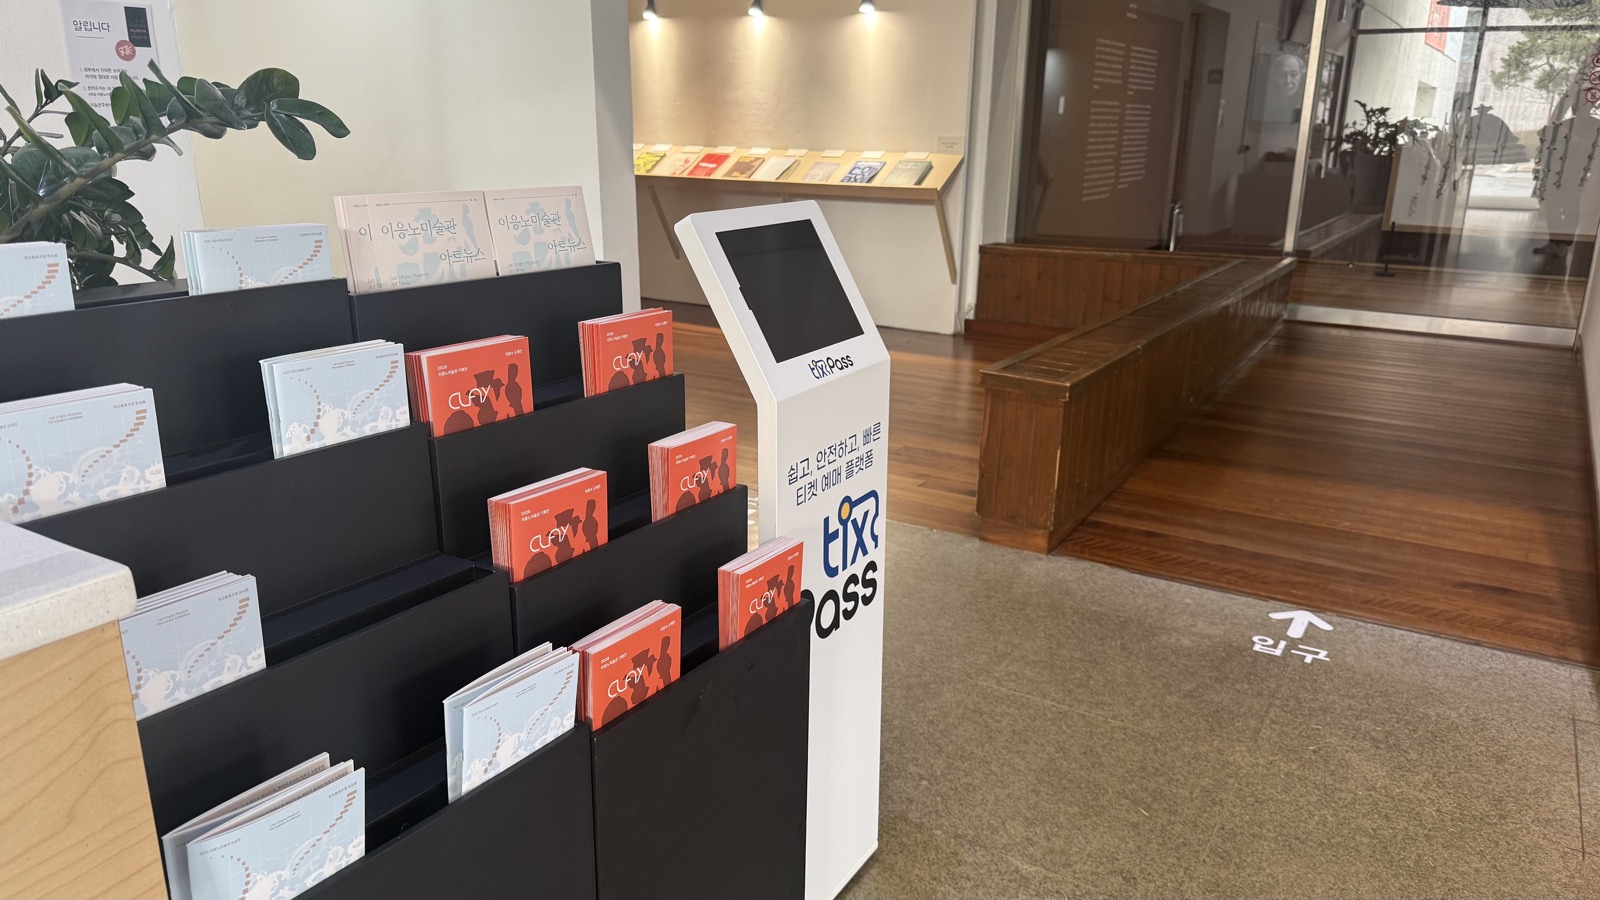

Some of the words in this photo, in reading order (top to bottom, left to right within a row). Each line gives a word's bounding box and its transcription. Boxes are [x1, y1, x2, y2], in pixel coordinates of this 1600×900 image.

[72, 20, 110, 32] 알립니다
[381, 218, 457, 240] 이응노미술관
[498, 211, 561, 231] 이응노미술관
[440, 248, 486, 266] 아트뉴스
[547, 238, 587, 254] 아트뉴스
[613, 350, 644, 370] CLAY
[448, 385, 491, 410] CLAY
[788, 457, 813, 486] 쉽고,
[816, 434, 859, 471] 안전하고,
[863, 422, 881, 446] 빠른
[680, 467, 710, 491] CLAY
[796, 478, 818, 506] 티켓
[821, 465, 842, 492] 예매
[845, 449, 873, 480] 플랫폼
[529, 523, 570, 552] CLAY
[823, 490, 879, 578] tix
[749, 587, 776, 614] CLAY
[1251, 636, 1330, 664] 입구
[607, 663, 645, 698] CLAY
